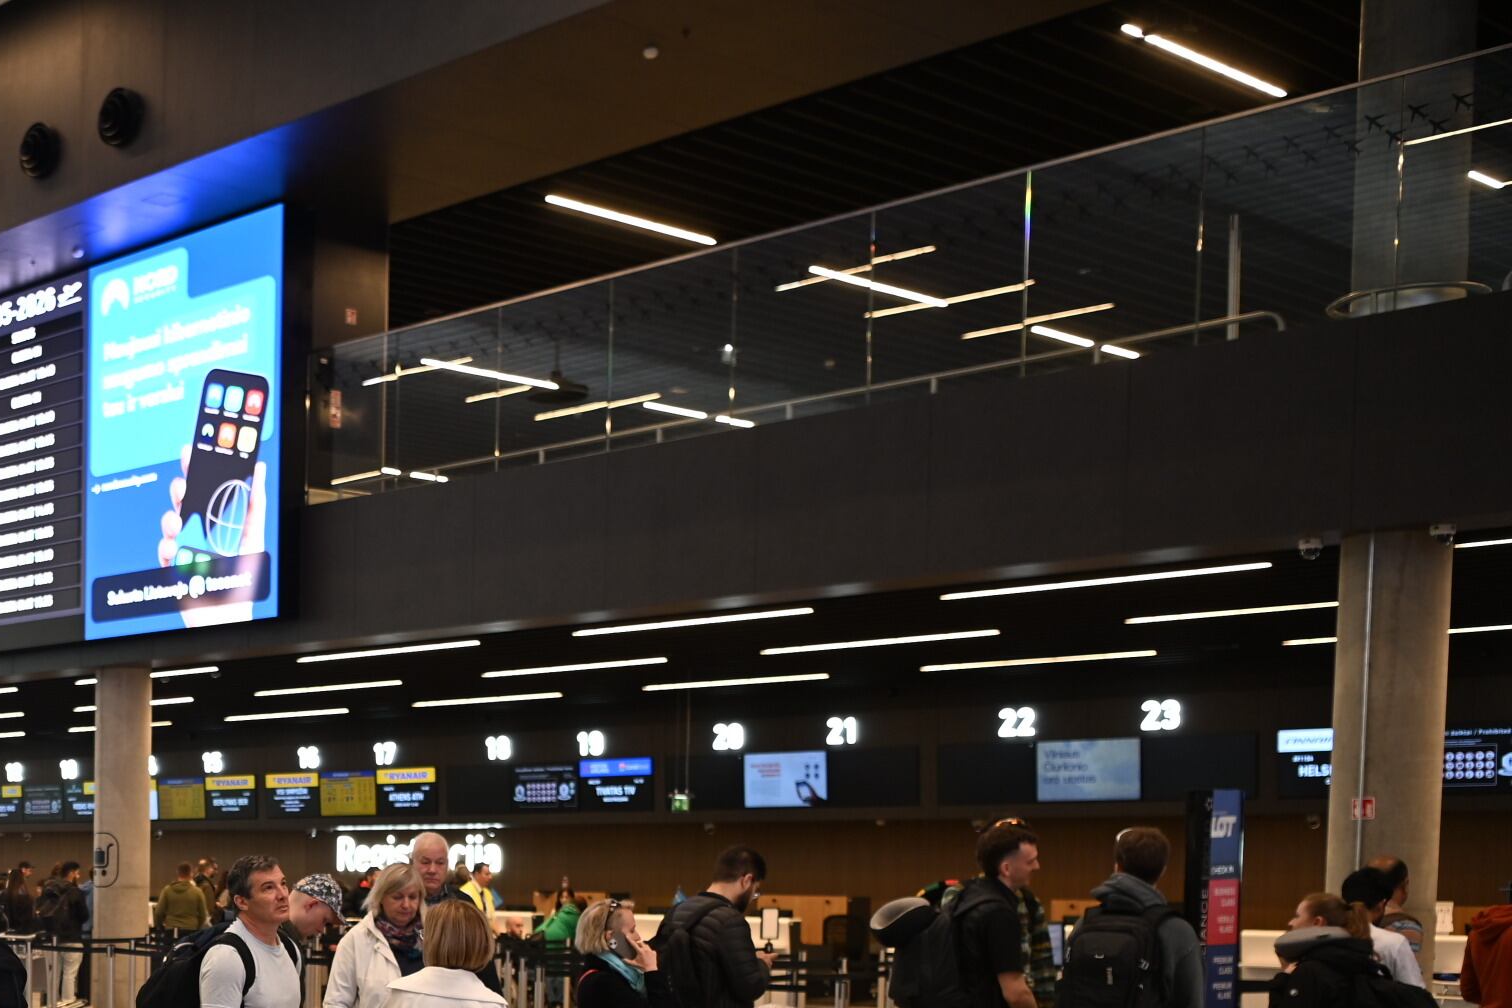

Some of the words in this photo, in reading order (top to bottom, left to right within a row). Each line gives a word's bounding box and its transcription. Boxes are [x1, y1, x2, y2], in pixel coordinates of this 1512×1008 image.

[998, 707, 1035, 737] 22
[1141, 699, 1181, 731] 23
[577, 730, 605, 756] 19
[713, 723, 745, 750] 20
[826, 717, 857, 745] 21
[373, 742, 398, 765] 17
[214, 778, 249, 788] RYANAIR
[276, 776, 312, 786] RYANAIR
[387, 771, 429, 781] RYANAIR
[1210, 815, 1237, 838] LOT
